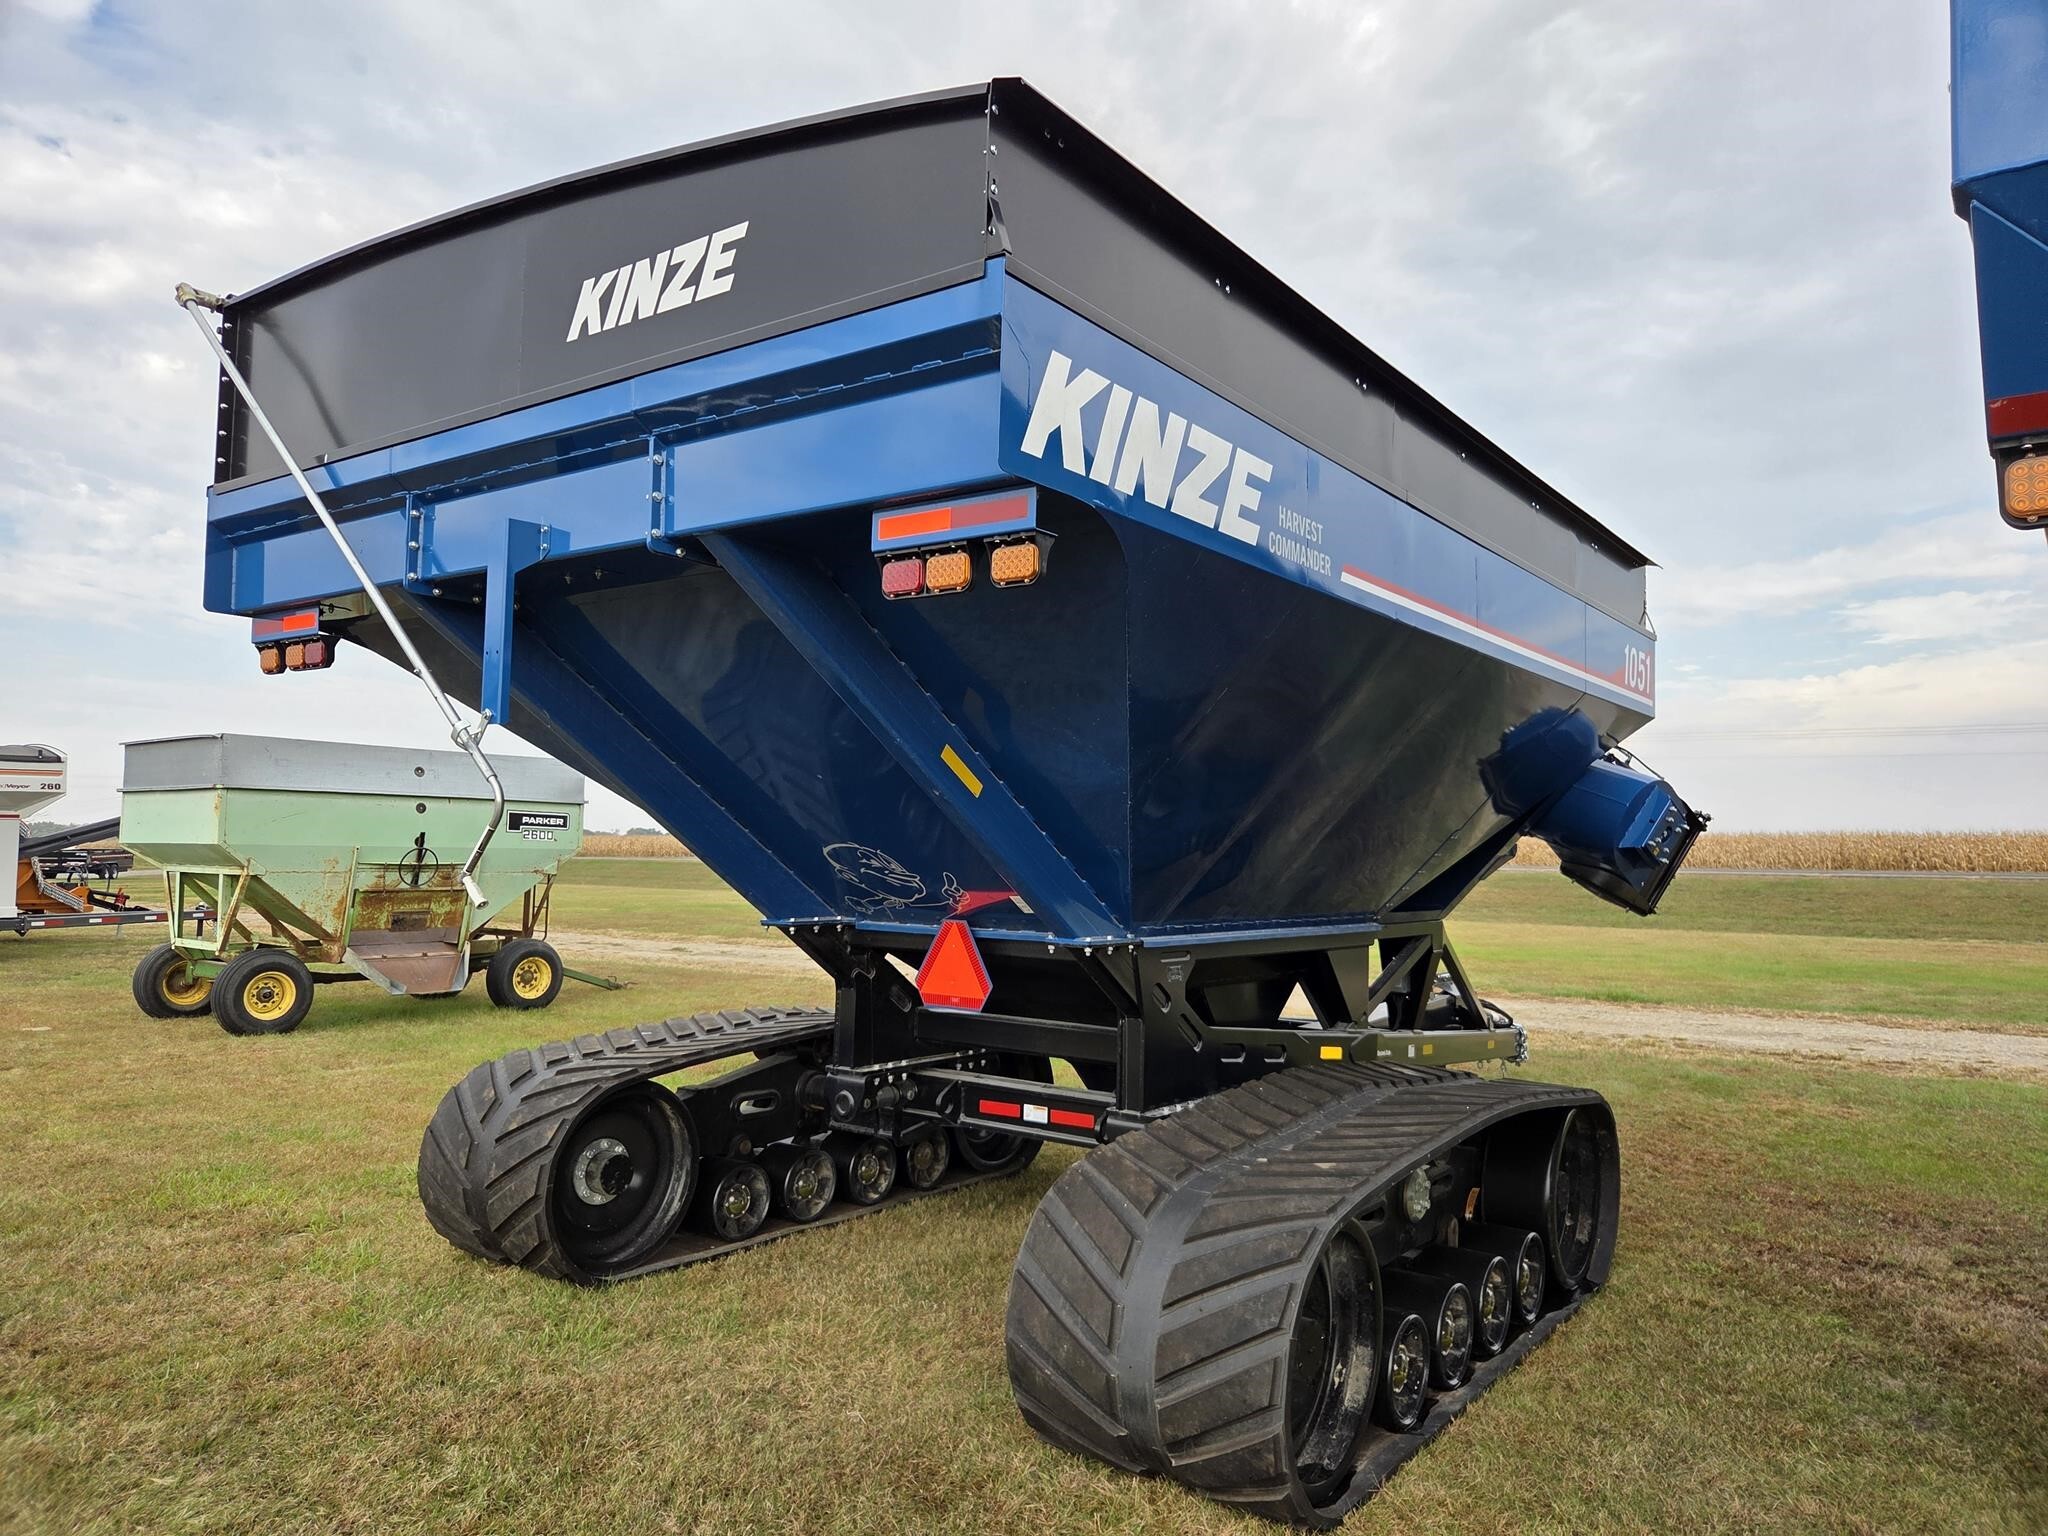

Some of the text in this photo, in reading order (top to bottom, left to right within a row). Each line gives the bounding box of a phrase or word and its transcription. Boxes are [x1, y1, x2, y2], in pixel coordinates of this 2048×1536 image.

[566, 220, 749, 342] KINZE
[1020, 350, 1273, 546] KINZE
[1279, 504, 1323, 545] HARVEST
[1268, 530, 1332, 577] COMMANDER
[1624, 643, 1651, 695] 1051
[40, 782, 61, 790] 260
[522, 816, 564, 826] PARKER
[522, 829, 554, 841] 2600
